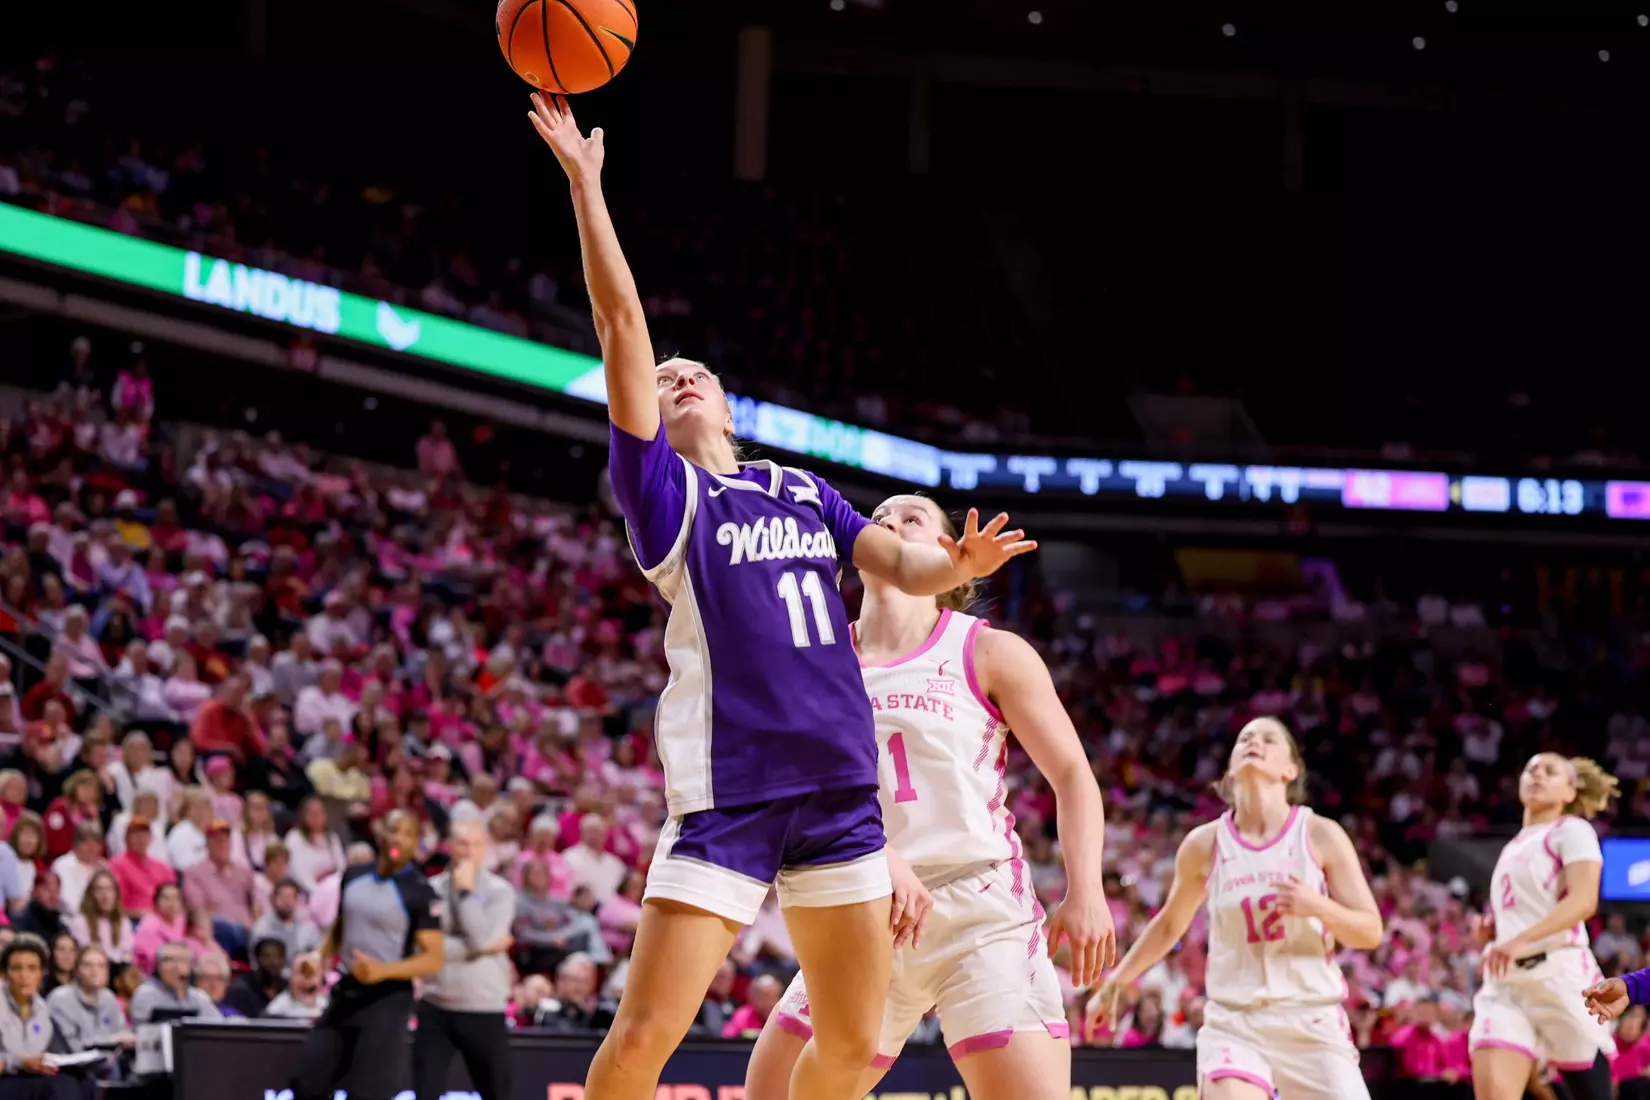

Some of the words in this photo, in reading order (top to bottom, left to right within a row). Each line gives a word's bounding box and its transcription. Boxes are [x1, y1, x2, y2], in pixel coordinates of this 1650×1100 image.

[184, 251, 341, 335] LANDUS
[777, 570, 837, 648] 11
[887, 694, 954, 721] STATE
[887, 732, 918, 804] 1
[1241, 894, 1285, 944] 12
[1502, 873, 1516, 911] 2
